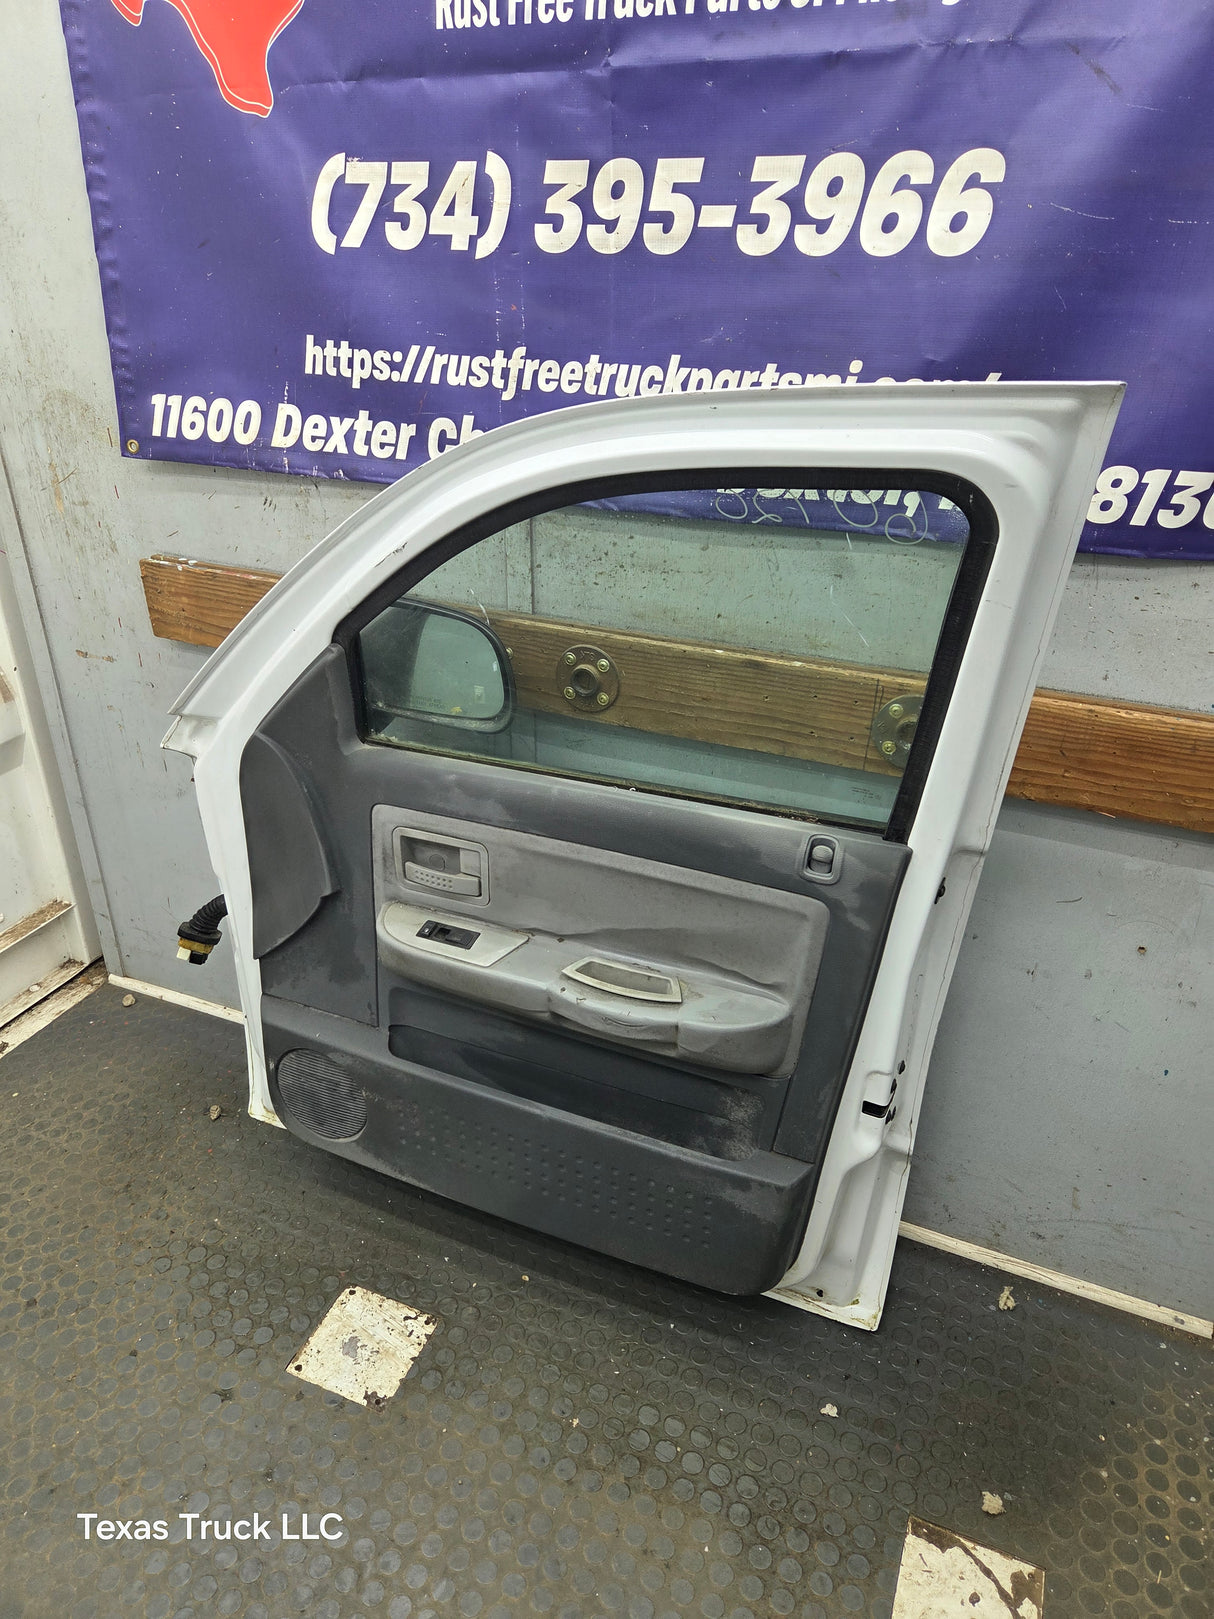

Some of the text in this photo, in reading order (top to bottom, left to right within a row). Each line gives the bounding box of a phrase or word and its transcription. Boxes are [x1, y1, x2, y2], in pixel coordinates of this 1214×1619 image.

[311, 147, 1006, 260] (734) 395-3966
[151, 393, 262, 445] 11600
[271, 403, 416, 461] Dexter
